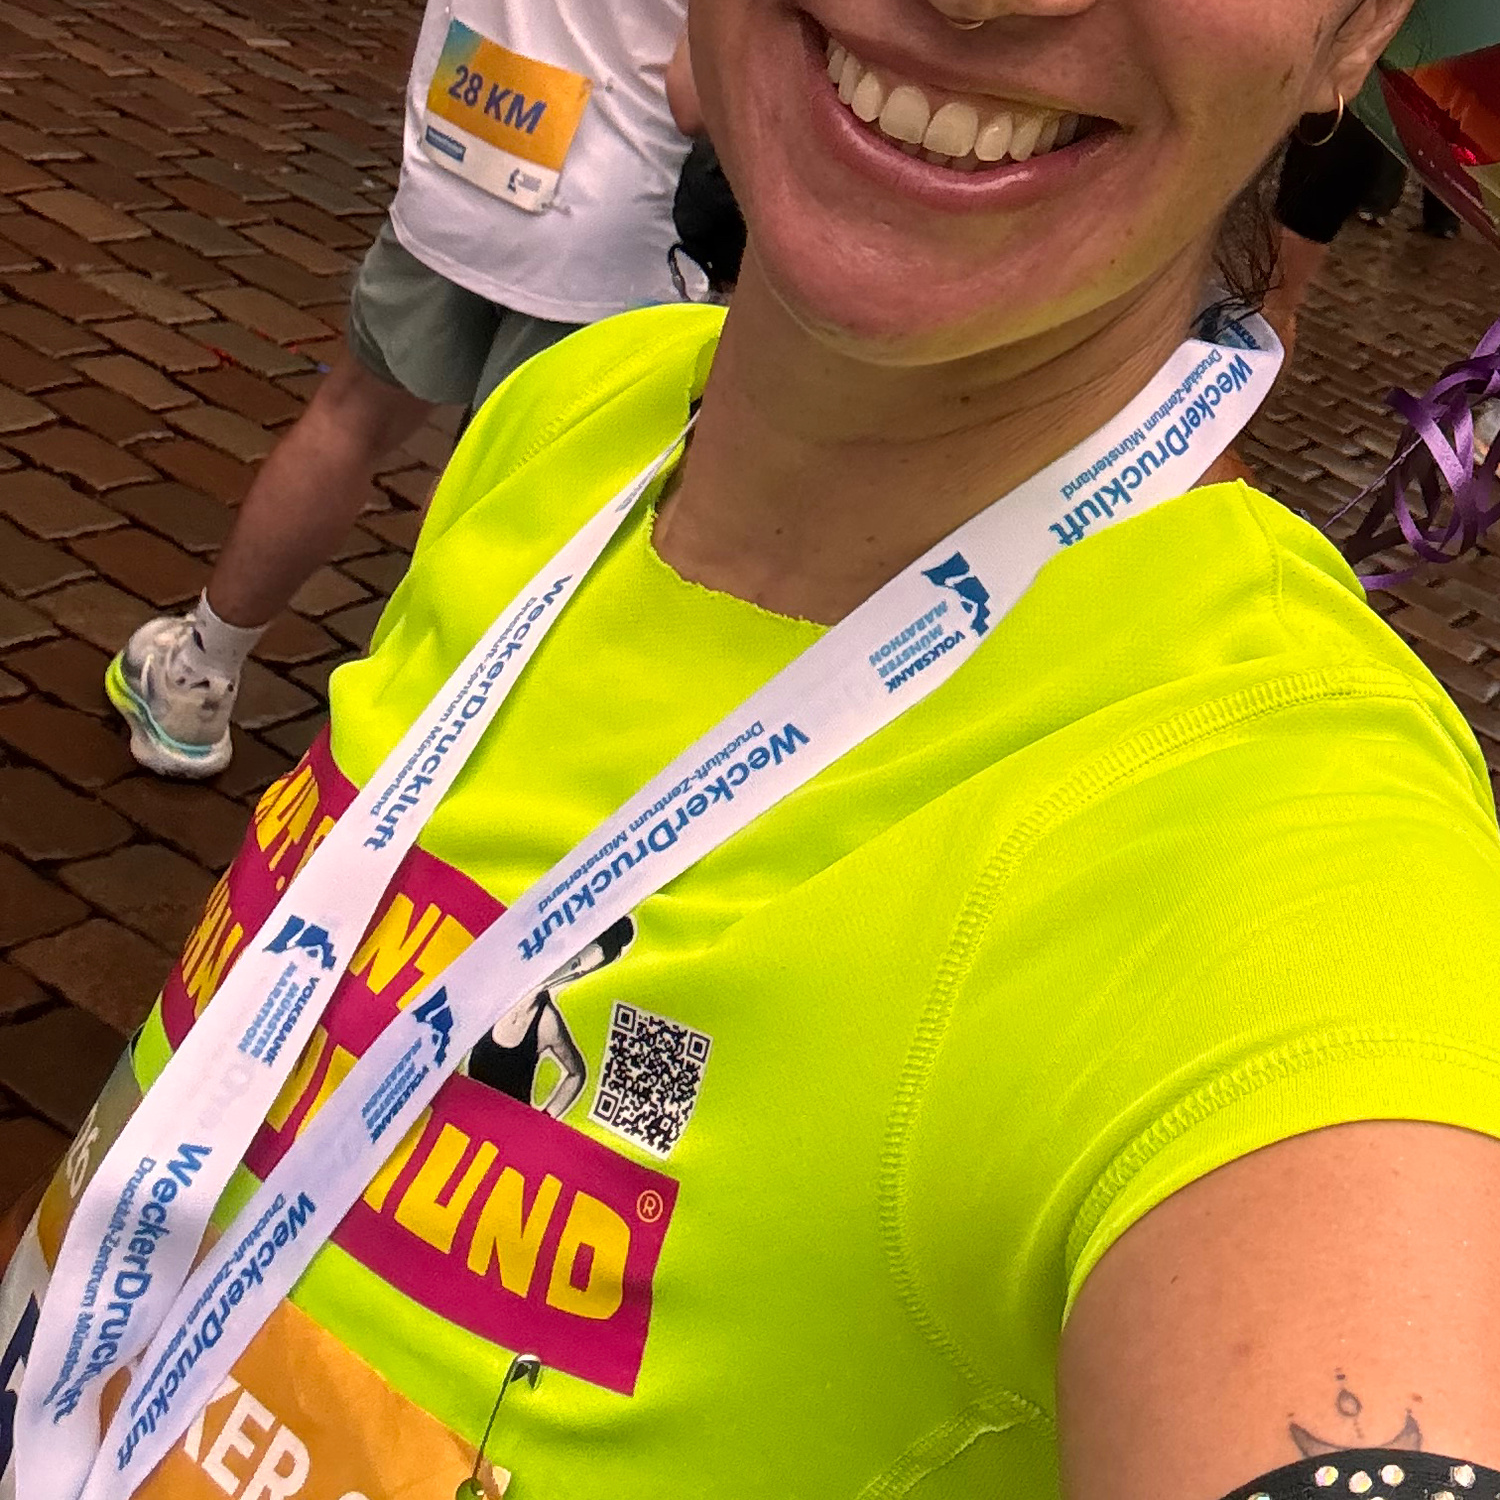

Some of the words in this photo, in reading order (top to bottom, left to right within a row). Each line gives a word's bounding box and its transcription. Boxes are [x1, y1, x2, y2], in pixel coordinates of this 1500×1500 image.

[448, 64, 484, 107] 28
[483, 82, 548, 134] KM
[1049, 353, 1253, 546] WeckerDruckluft
[1060, 426, 1147, 501] Münsterland
[868, 600, 948, 667] MARATHON
[876, 623, 944, 678] MÜNSTER
[884, 630, 966, 694] VOLKSBANK
[363, 575, 573, 851] WeckerDruckluft
[370, 726, 443, 816] Münsterland
[628, 720, 765, 833] Druckluft-Zentrum
[517, 722, 810, 962] WeckerDruckluft
[538, 823, 628, 913] Münsterland
[262, 976, 320, 1067] VOLKSBANK
